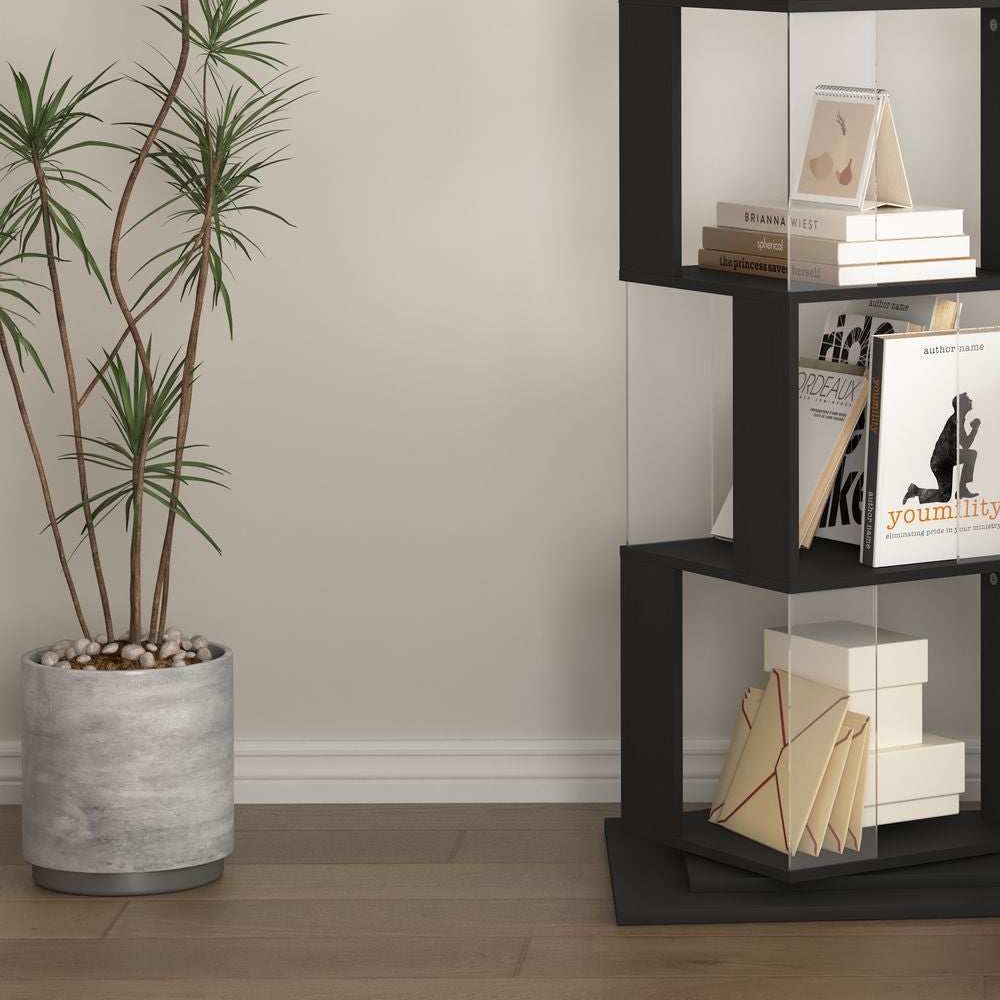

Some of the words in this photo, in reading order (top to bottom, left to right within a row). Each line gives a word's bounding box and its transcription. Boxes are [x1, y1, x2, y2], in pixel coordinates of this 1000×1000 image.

[744, 212, 787, 227] BRIANNA
[790, 217, 819, 230] WIEST
[757, 238, 784, 251] spherical
[719, 255, 733, 267] the
[733, 258, 768, 273] princess
[791, 264, 822, 279] herself
[868, 299, 892, 310] author
[891, 302, 910, 312] name
[923, 345, 956, 355] author
[958, 343, 985, 353] name
[798, 371, 861, 402] ORDEAUX
[871, 377, 881, 434] youmility
[885, 529, 925, 540] eliminating
[926, 527, 944, 537] pride
[953, 525, 972, 535] your
